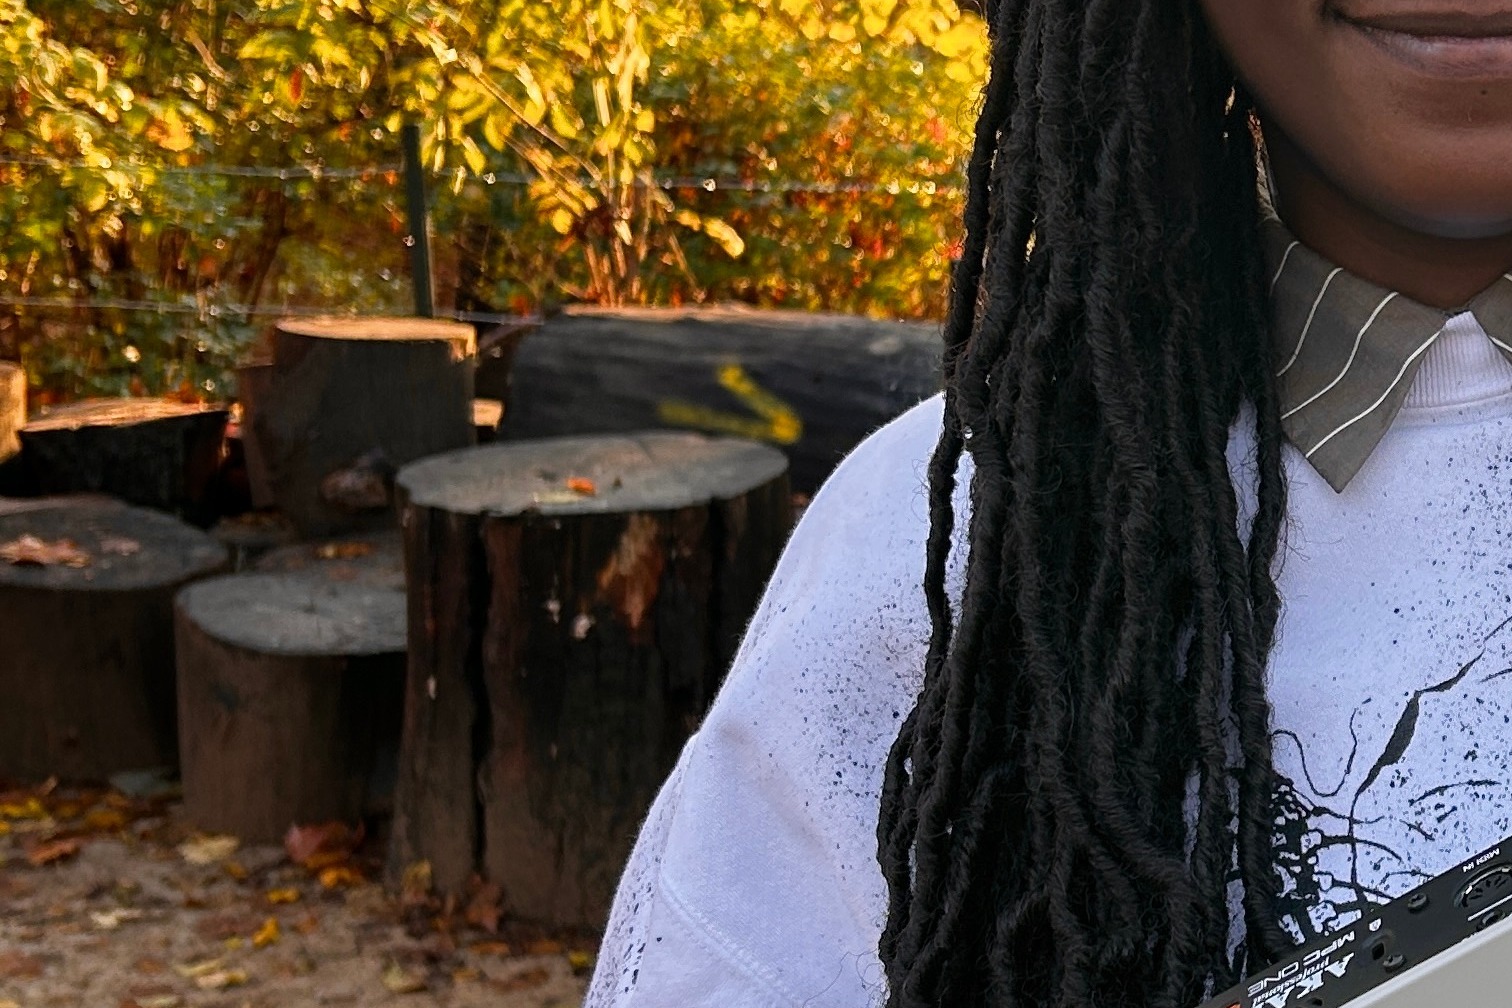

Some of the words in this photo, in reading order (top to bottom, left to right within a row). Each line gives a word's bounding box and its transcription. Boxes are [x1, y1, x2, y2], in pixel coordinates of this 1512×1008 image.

[1477, 848, 1500, 865] MIDI
[1302, 930, 1355, 966] MPC
[1247, 961, 1299, 998] ONE
